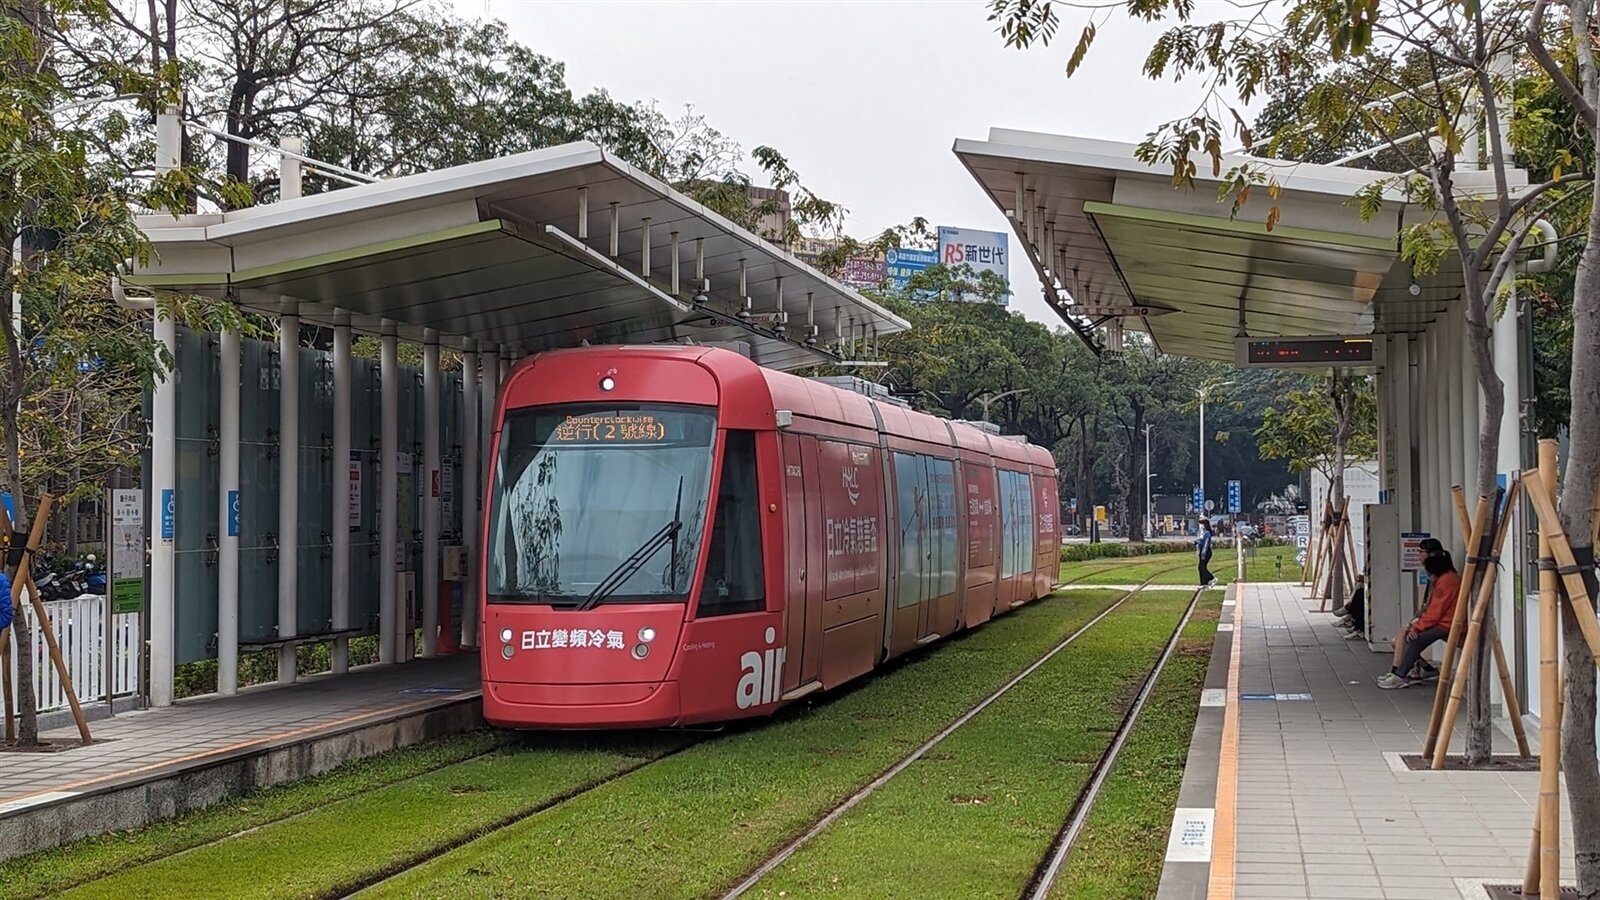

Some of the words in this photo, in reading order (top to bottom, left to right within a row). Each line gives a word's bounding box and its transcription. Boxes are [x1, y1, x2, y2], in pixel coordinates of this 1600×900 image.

[944, 243, 1004, 266] R5新世代
[521, 628, 626, 651] 日立變頻冷氣
[736, 626, 787, 710] air
